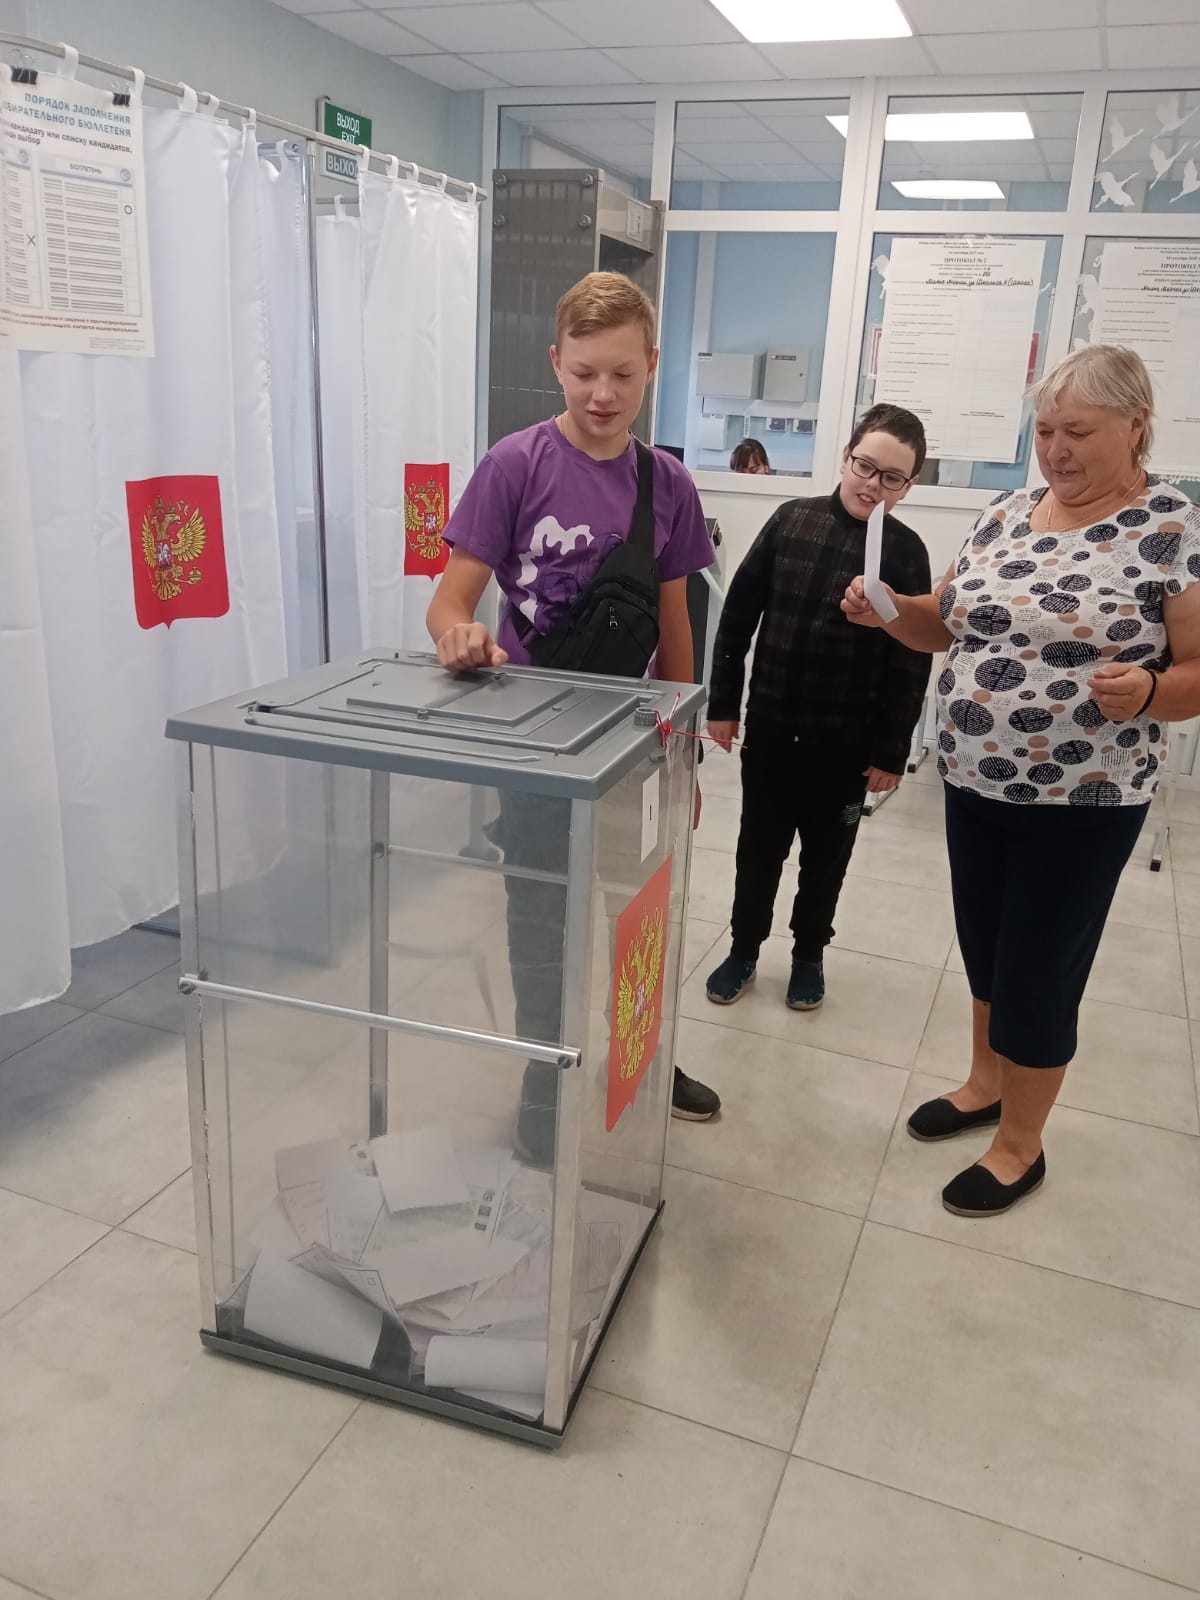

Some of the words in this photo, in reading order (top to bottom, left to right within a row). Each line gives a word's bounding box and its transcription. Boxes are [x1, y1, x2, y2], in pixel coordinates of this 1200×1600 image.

[25, 93, 70, 112] ПОРЯДОК
[72, 104, 131, 124] ЗАПОЛНЕНИЯ
[78, 119, 132, 137] БЮЛЛЕТЕНЯ
[336, 112, 360, 136] ВЫХОД
[47, 131, 61, 139] или
[62, 134, 87, 147] списку
[341, 131, 356, 145] EXIT
